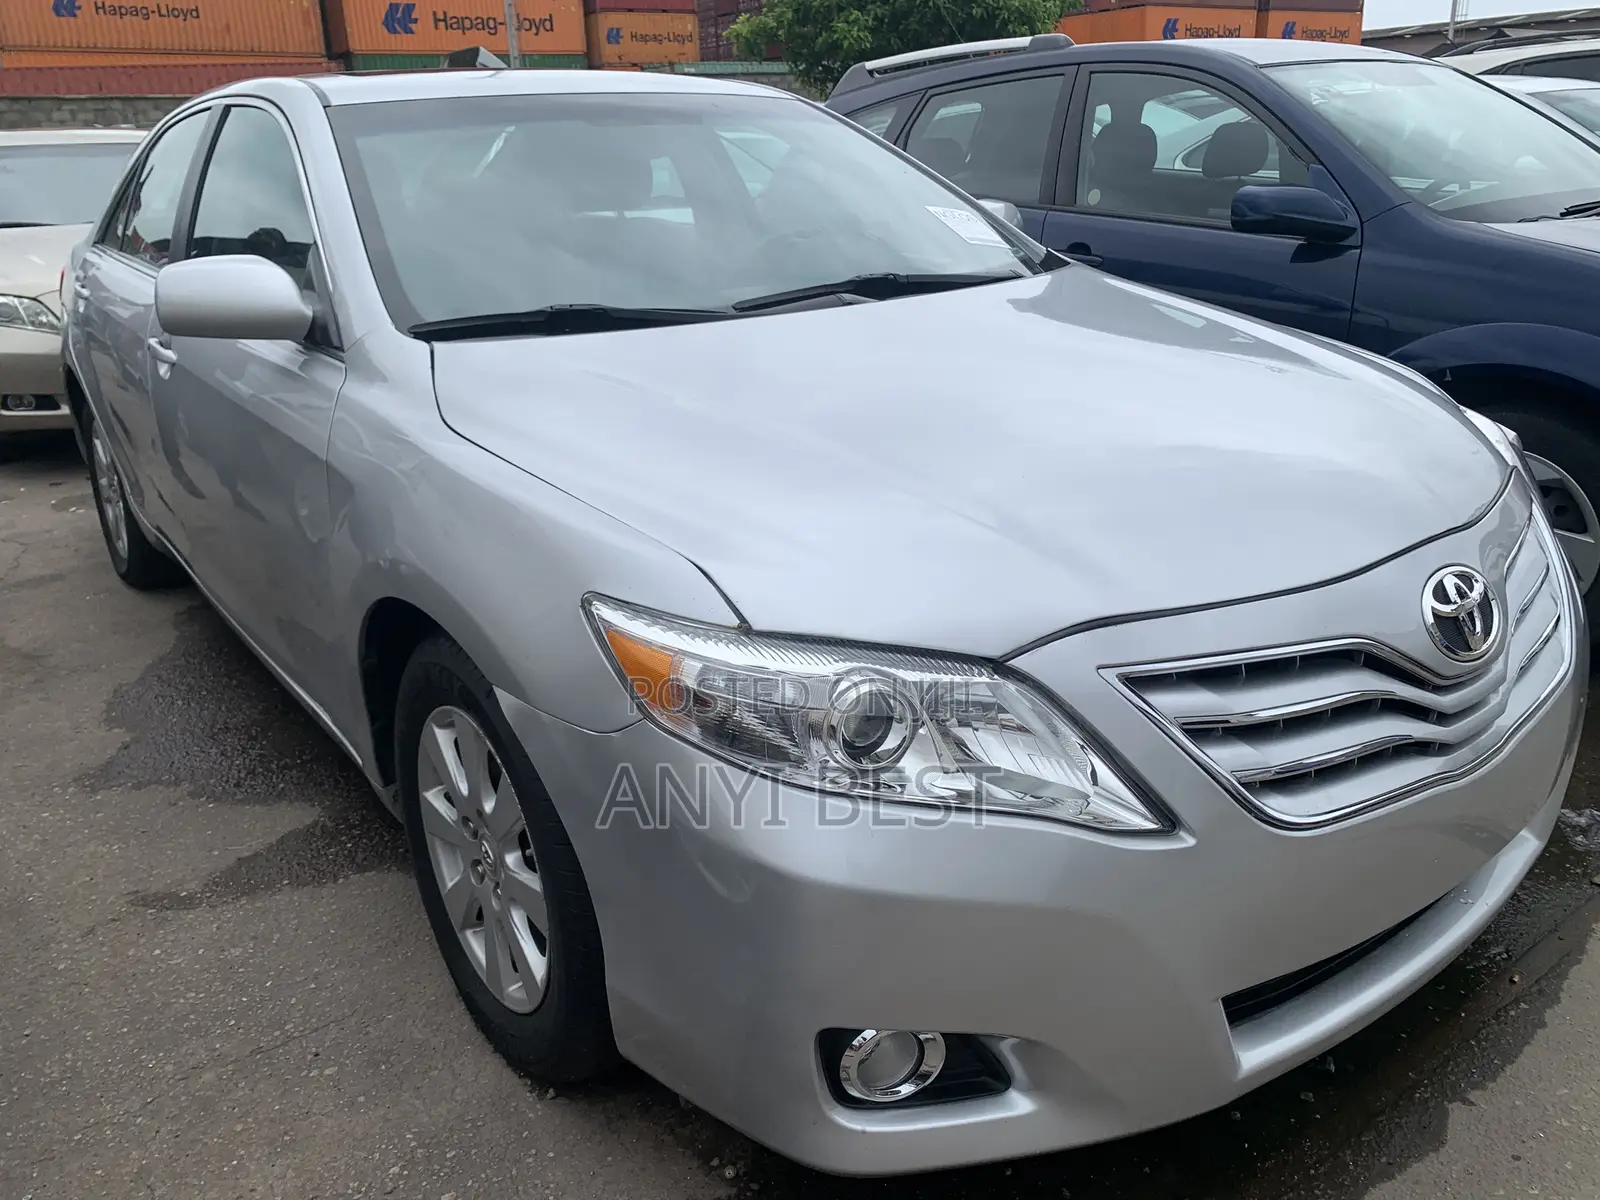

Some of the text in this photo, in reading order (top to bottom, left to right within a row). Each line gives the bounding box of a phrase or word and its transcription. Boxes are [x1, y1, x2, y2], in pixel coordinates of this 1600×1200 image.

[94, 0, 200, 21] Hapag-Lloyd
[432, 10, 554, 36] Hapag-loyd
[630, 31, 693, 45] Hapag-Lloyd
[1301, 26, 1350, 41] Hapag-Lloyd
